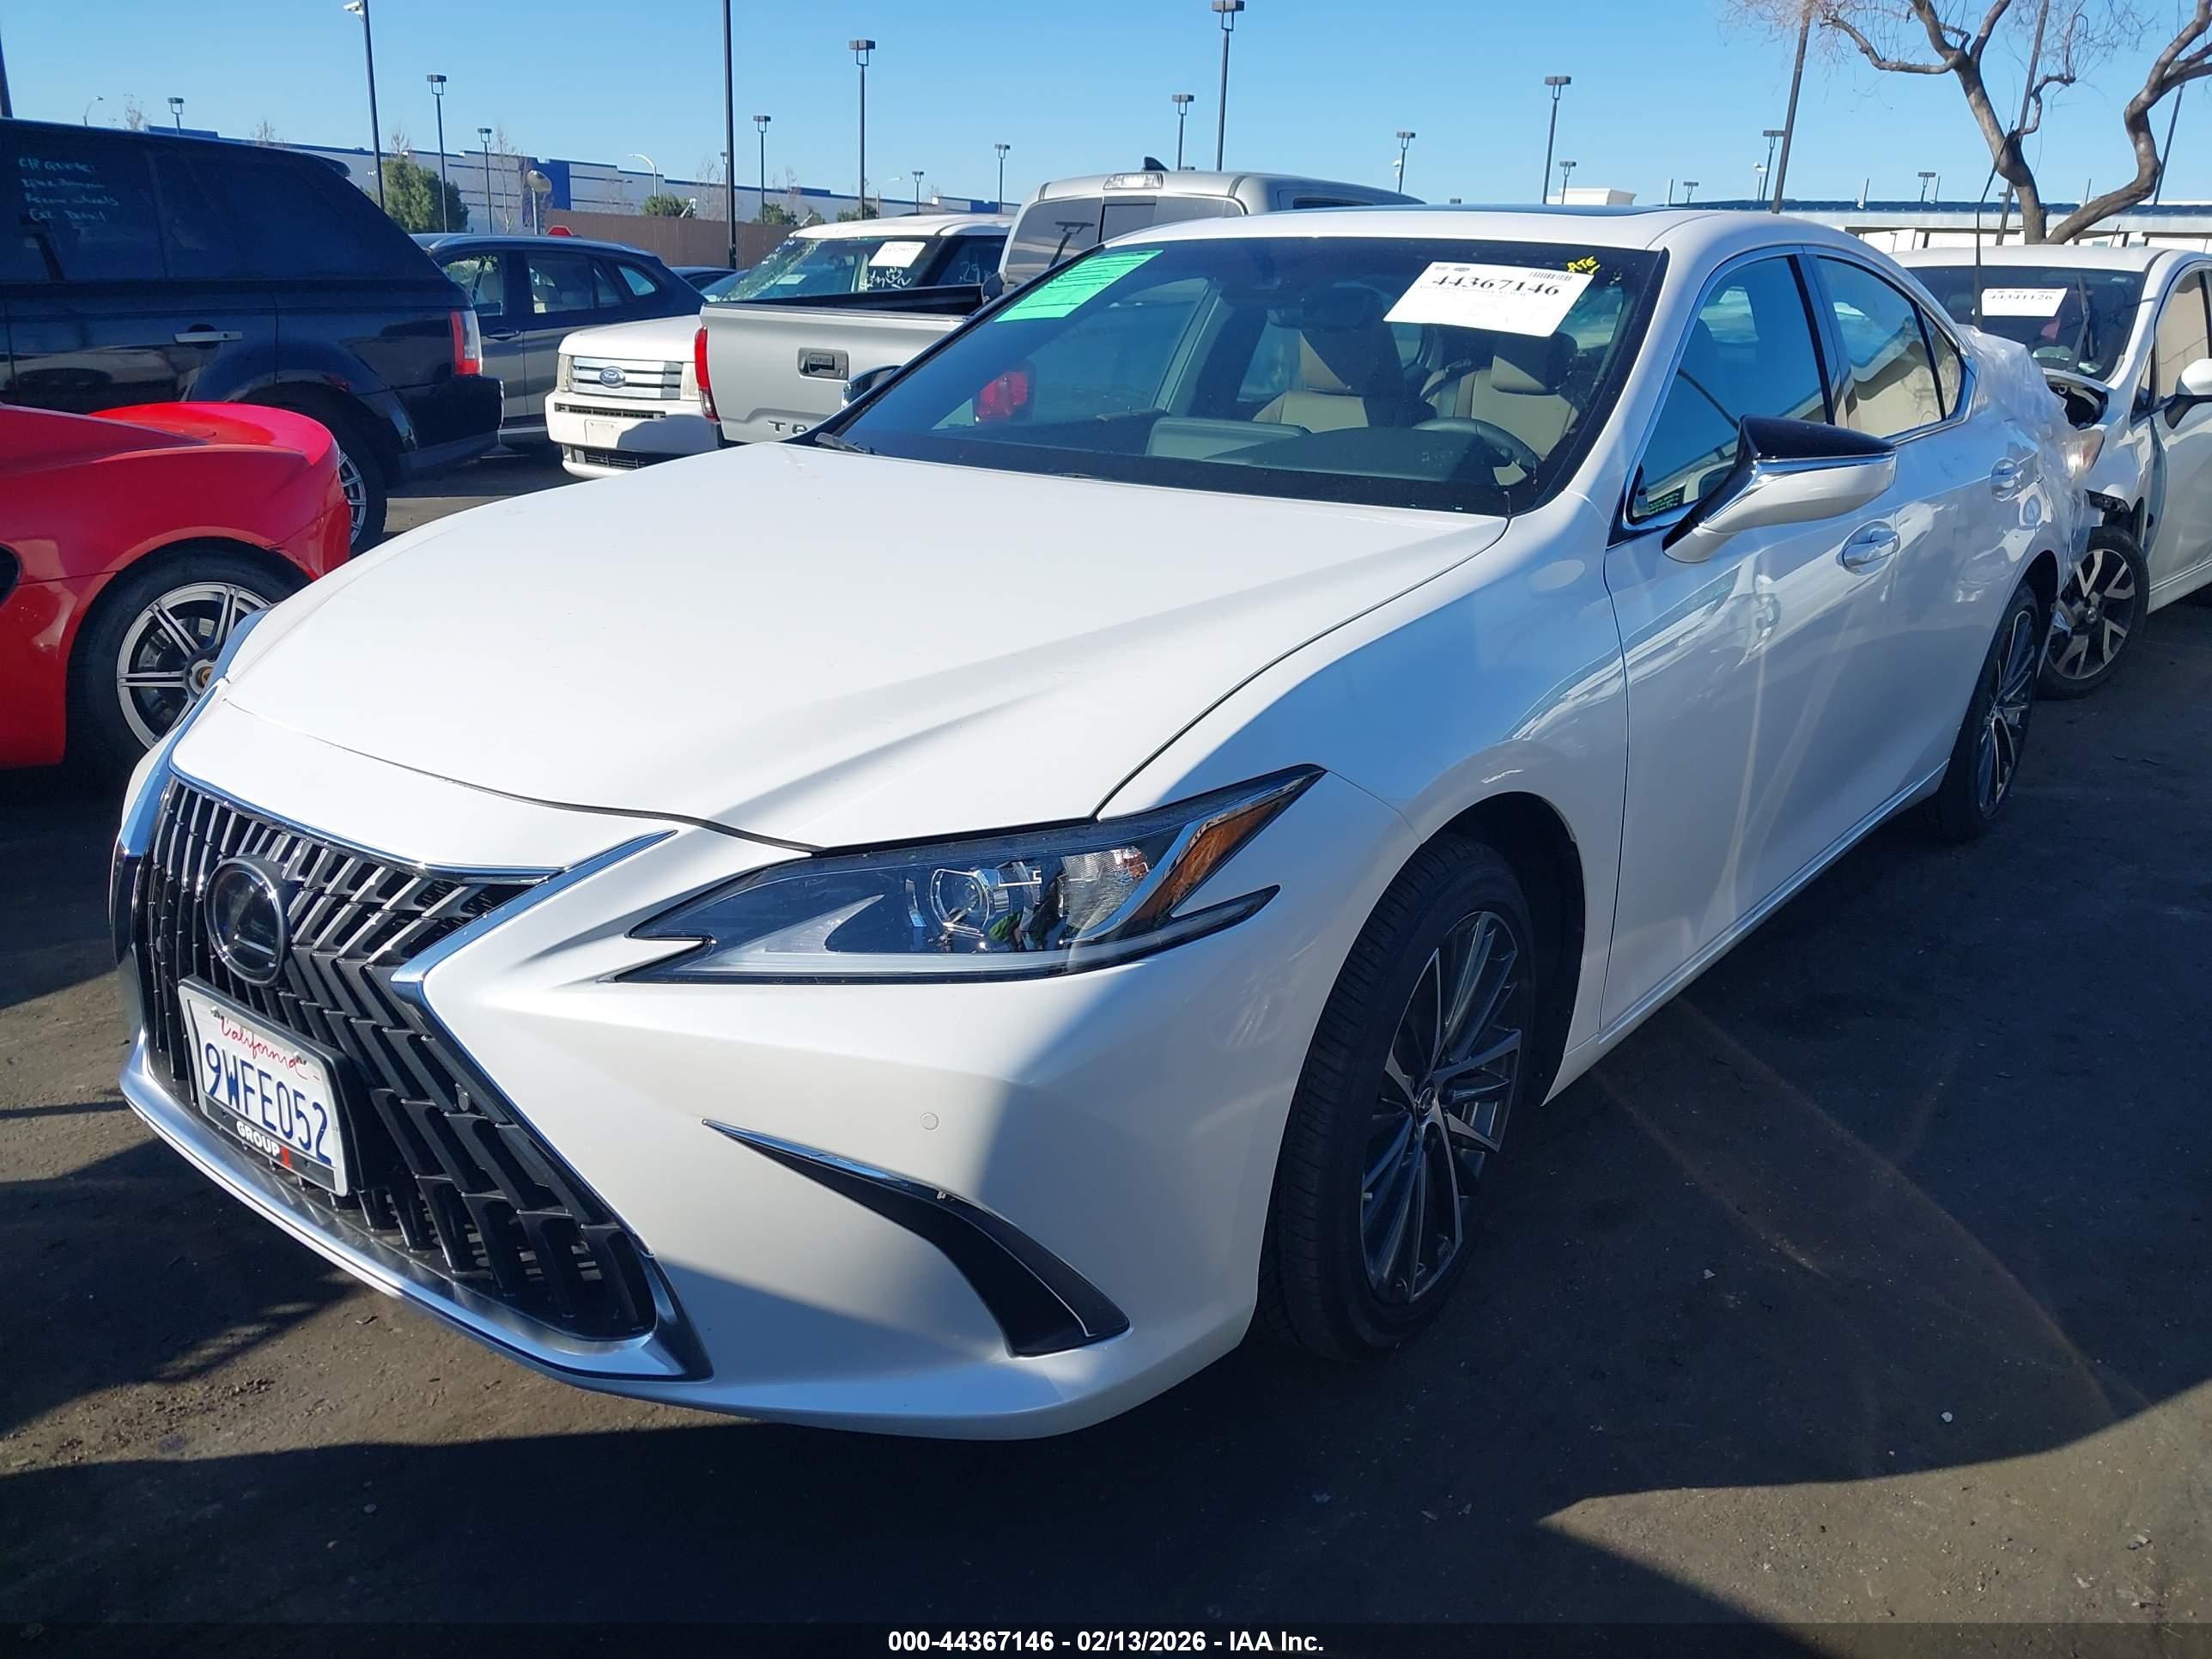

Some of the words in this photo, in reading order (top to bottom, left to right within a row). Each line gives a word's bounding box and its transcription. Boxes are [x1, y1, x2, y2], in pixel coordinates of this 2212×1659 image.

[1431, 275, 1562, 296] 44367146
[219, 1016, 308, 1080] California
[204, 1042, 332, 1168] 9WFE052
